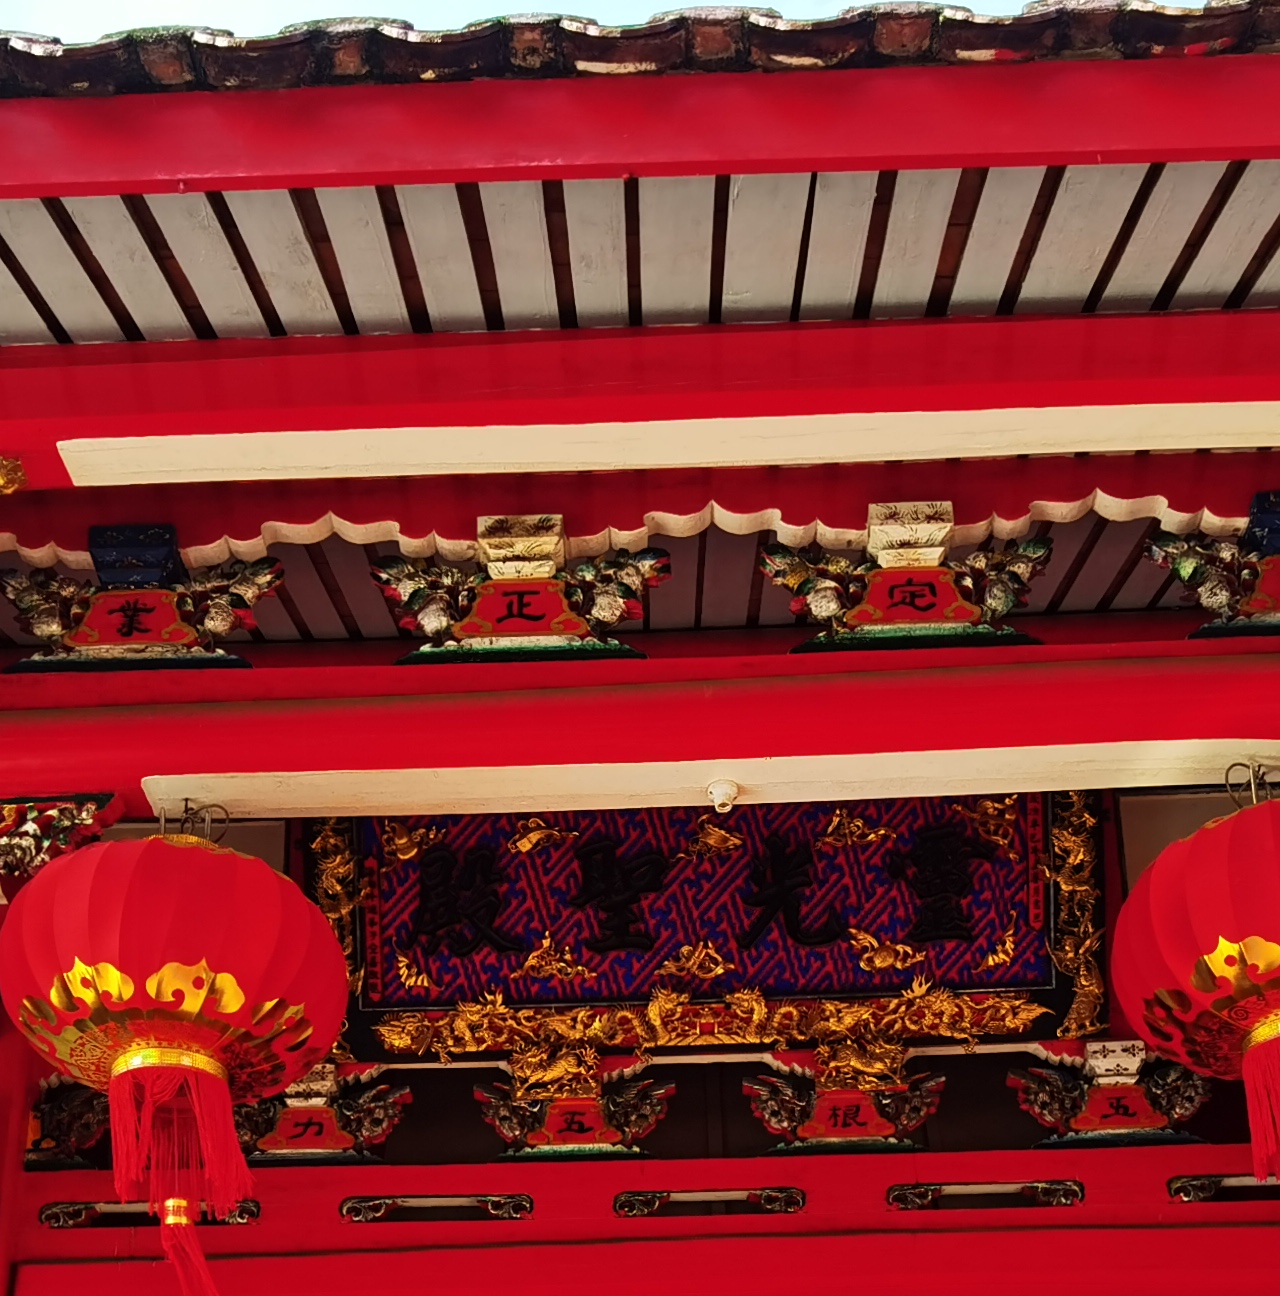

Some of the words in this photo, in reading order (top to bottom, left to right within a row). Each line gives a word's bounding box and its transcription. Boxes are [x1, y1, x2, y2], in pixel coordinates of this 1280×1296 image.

[500, 588, 546, 621] 正
[892, 577, 936, 610] 定
[109, 601, 155, 636] 業
[829, 1103, 867, 1128] 根
[1101, 1099, 1137, 1118] 五
[291, 1117, 326, 1141] 力
[558, 1113, 590, 1133] 五
